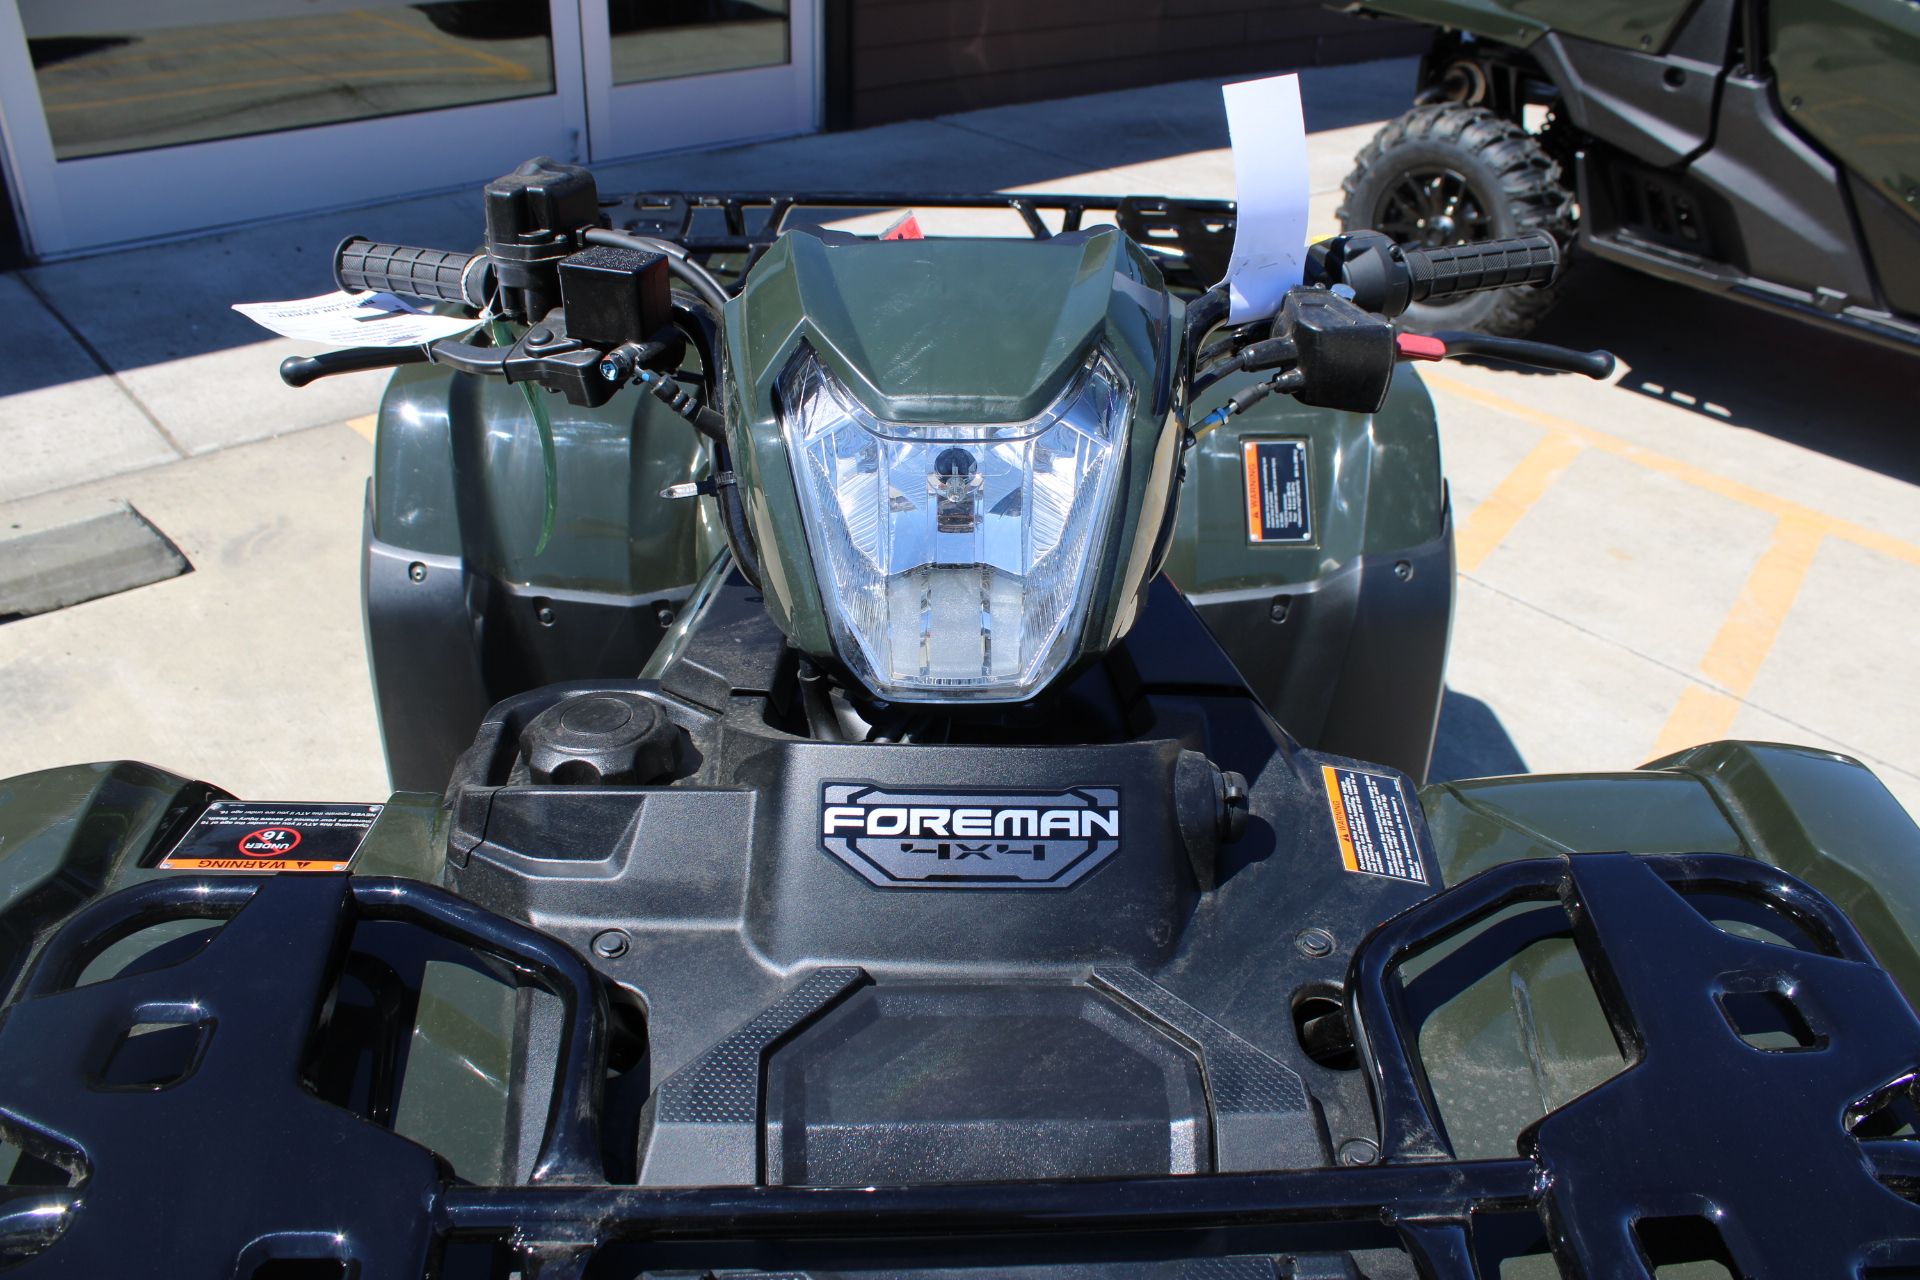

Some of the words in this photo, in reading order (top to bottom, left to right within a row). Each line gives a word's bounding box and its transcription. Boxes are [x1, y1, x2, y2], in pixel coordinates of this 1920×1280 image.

[823, 807, 1120, 837] FOREMAN
[1333, 800, 1345, 830] WARNING
[1354, 817, 1363, 834] change
